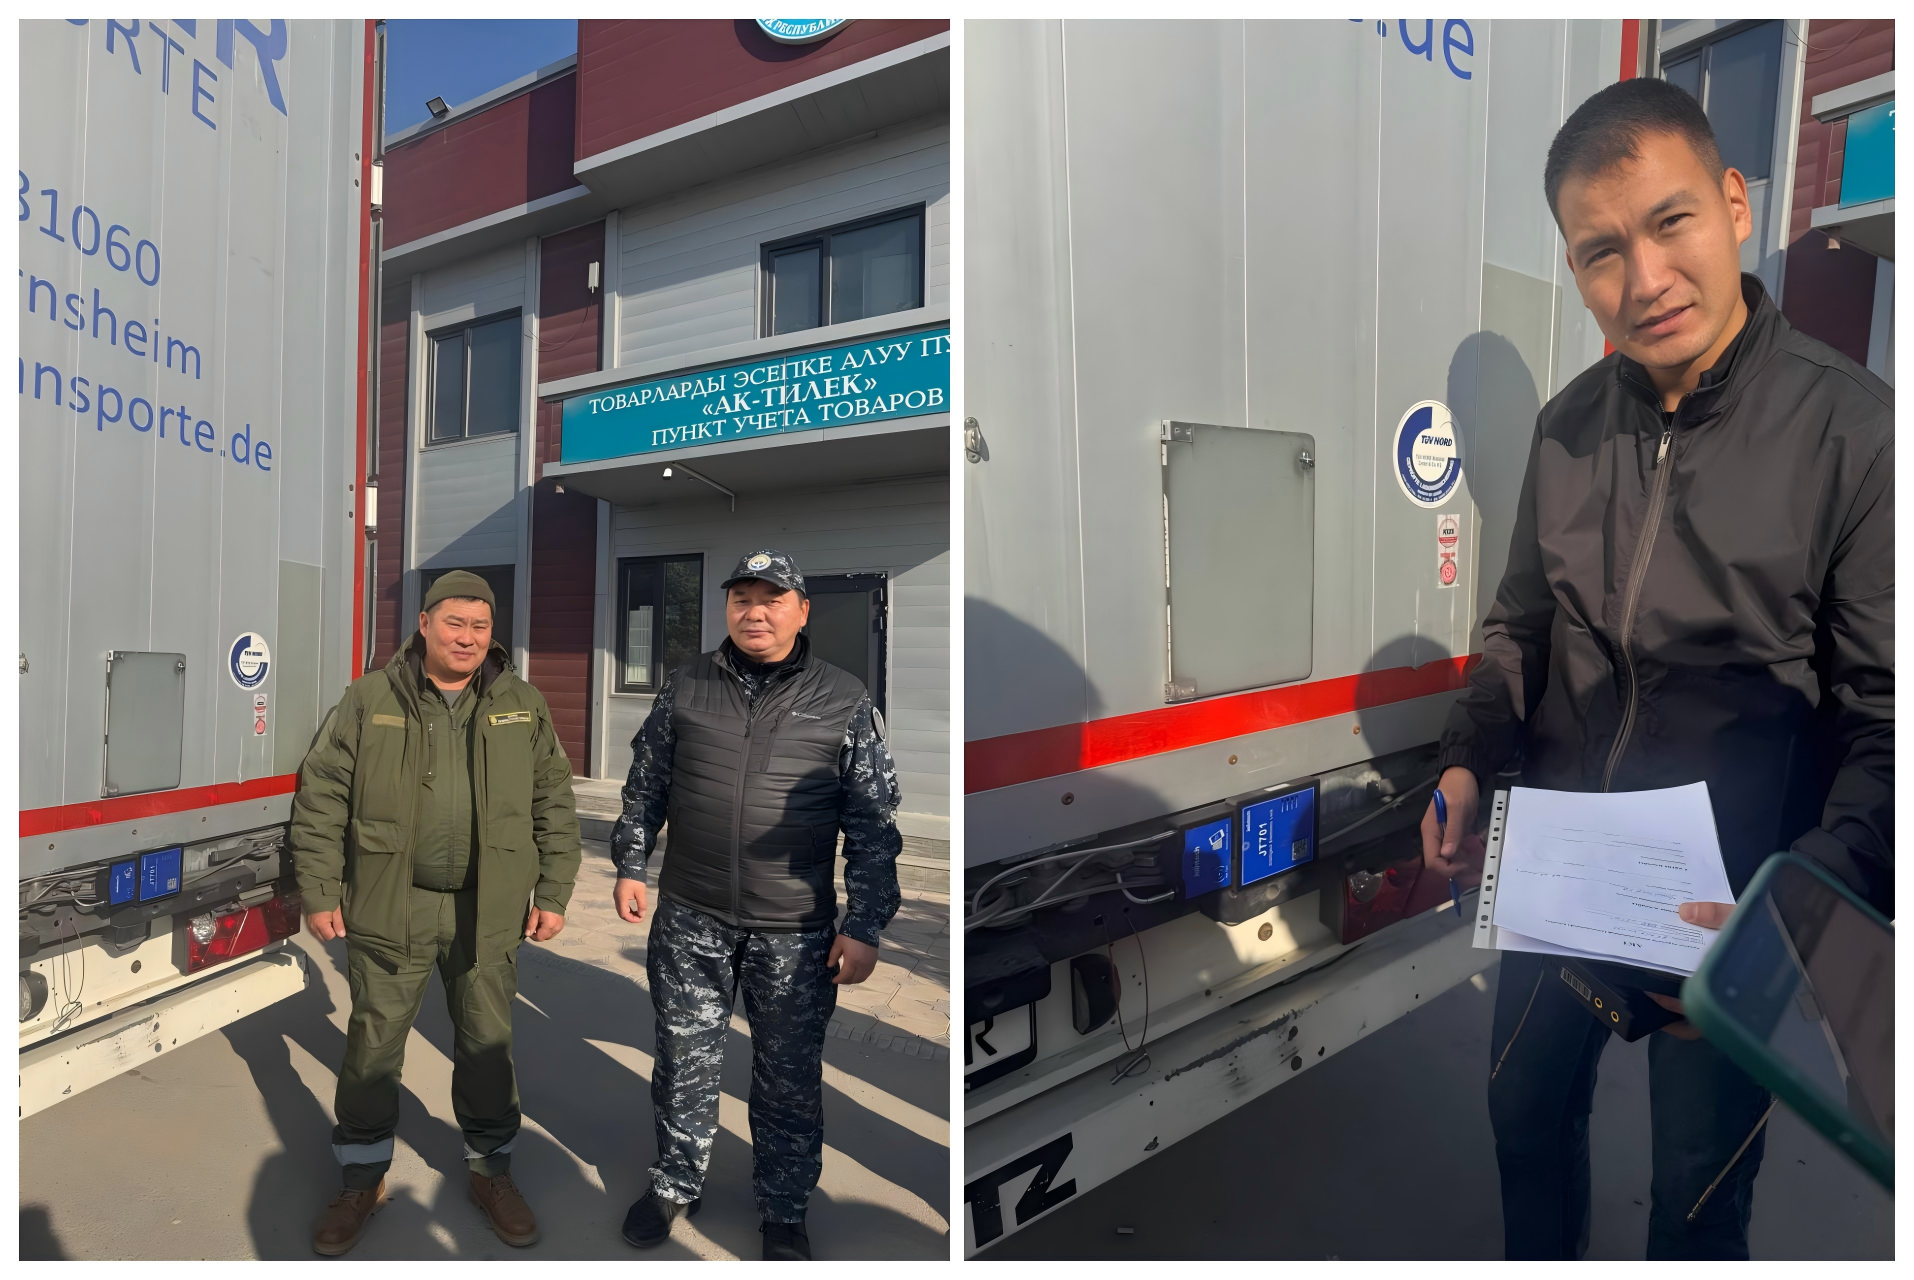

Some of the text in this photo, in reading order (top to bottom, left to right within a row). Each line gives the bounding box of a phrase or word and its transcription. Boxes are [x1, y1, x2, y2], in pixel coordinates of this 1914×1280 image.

[66, 19, 217, 130] RTE
[19, 268, 201, 380] nsheim
[589, 374, 726, 415] ТОВАРЛАРДЫ
[733, 356, 832, 388] ЭСЕПКЕ
[840, 341, 912, 371] АЛУУ
[701, 374, 878, 417] «АК-ТИЛЕК»
[19, 356, 273, 471] nsporte.de
[651, 387, 944, 447] ПУНКТ УЧЕТА ТОВАРОВ
[1433, 436, 1453, 447] NORD
[1258, 822, 1268, 856] JT701
